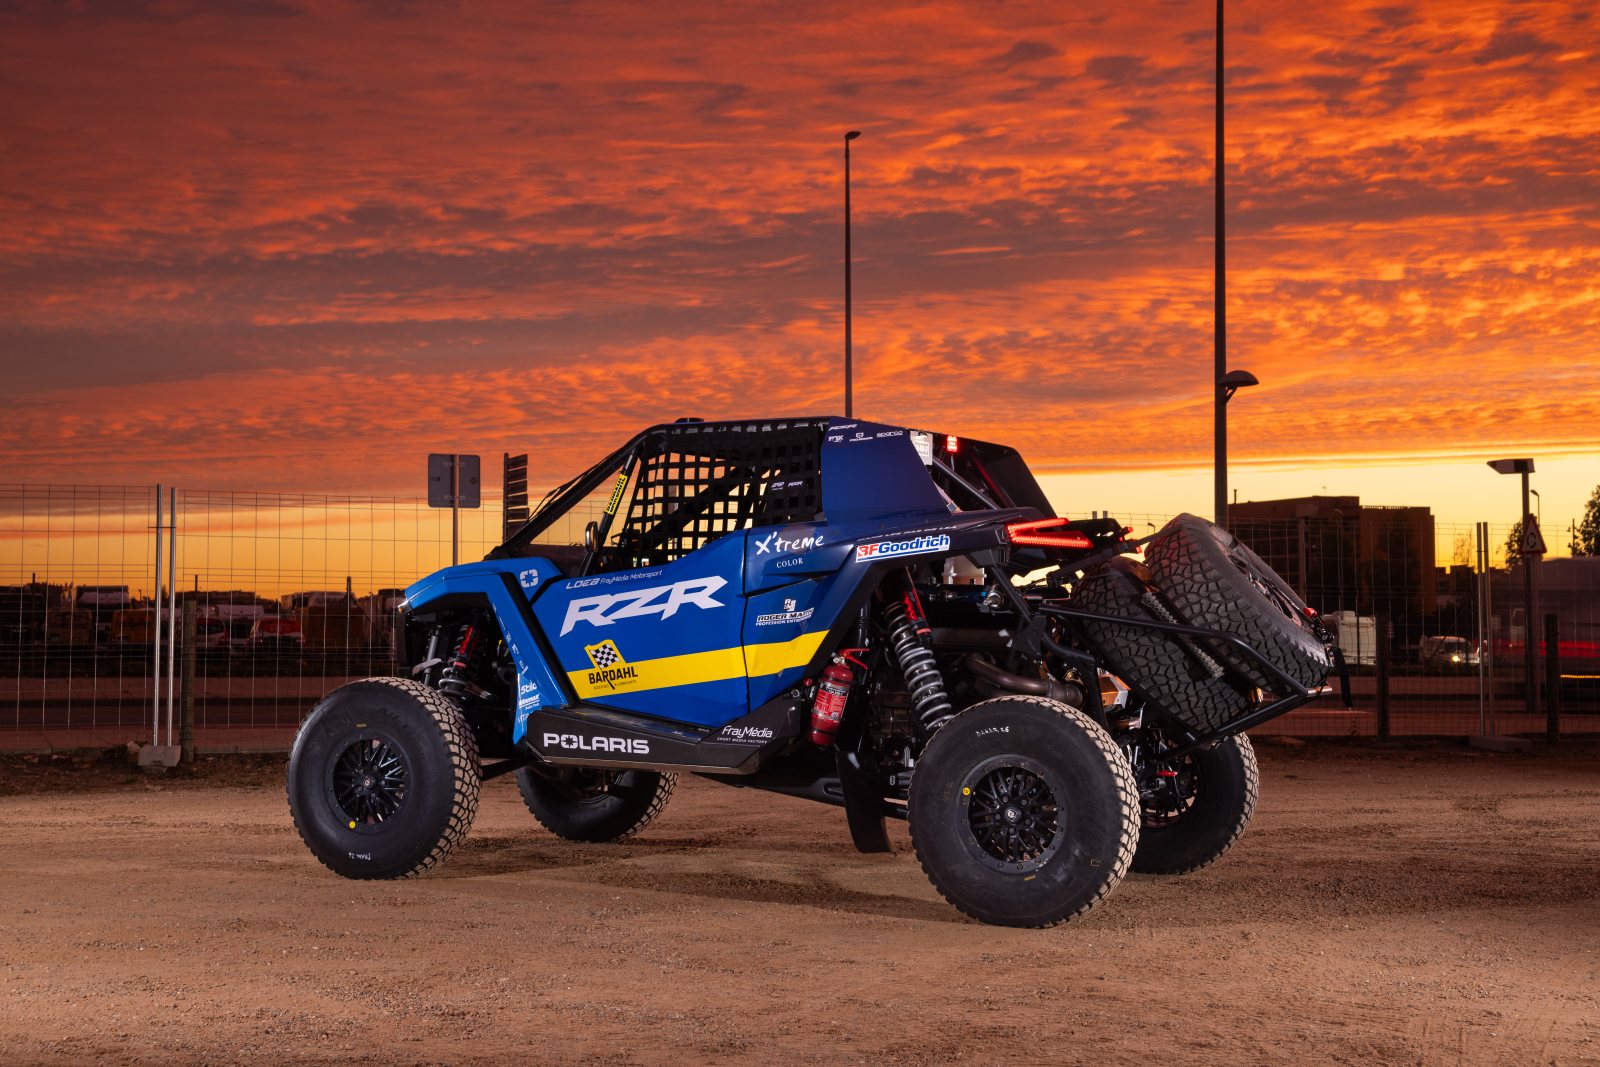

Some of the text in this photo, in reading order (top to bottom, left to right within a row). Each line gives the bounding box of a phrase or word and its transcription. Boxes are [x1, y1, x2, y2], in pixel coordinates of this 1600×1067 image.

[876, 430, 903, 438] sparco
[755, 531, 825, 555] X'treme
[857, 534, 950, 557] BFGoodrich
[776, 557, 804, 568] COLOR
[629, 570, 663, 580] Motorsport
[559, 575, 729, 638] RZR
[757, 613, 788, 621] ROGER
[588, 666, 639, 684] BARDAHL
[721, 725, 773, 739] FrayMédia
[543, 732, 650, 755] POLARIS
